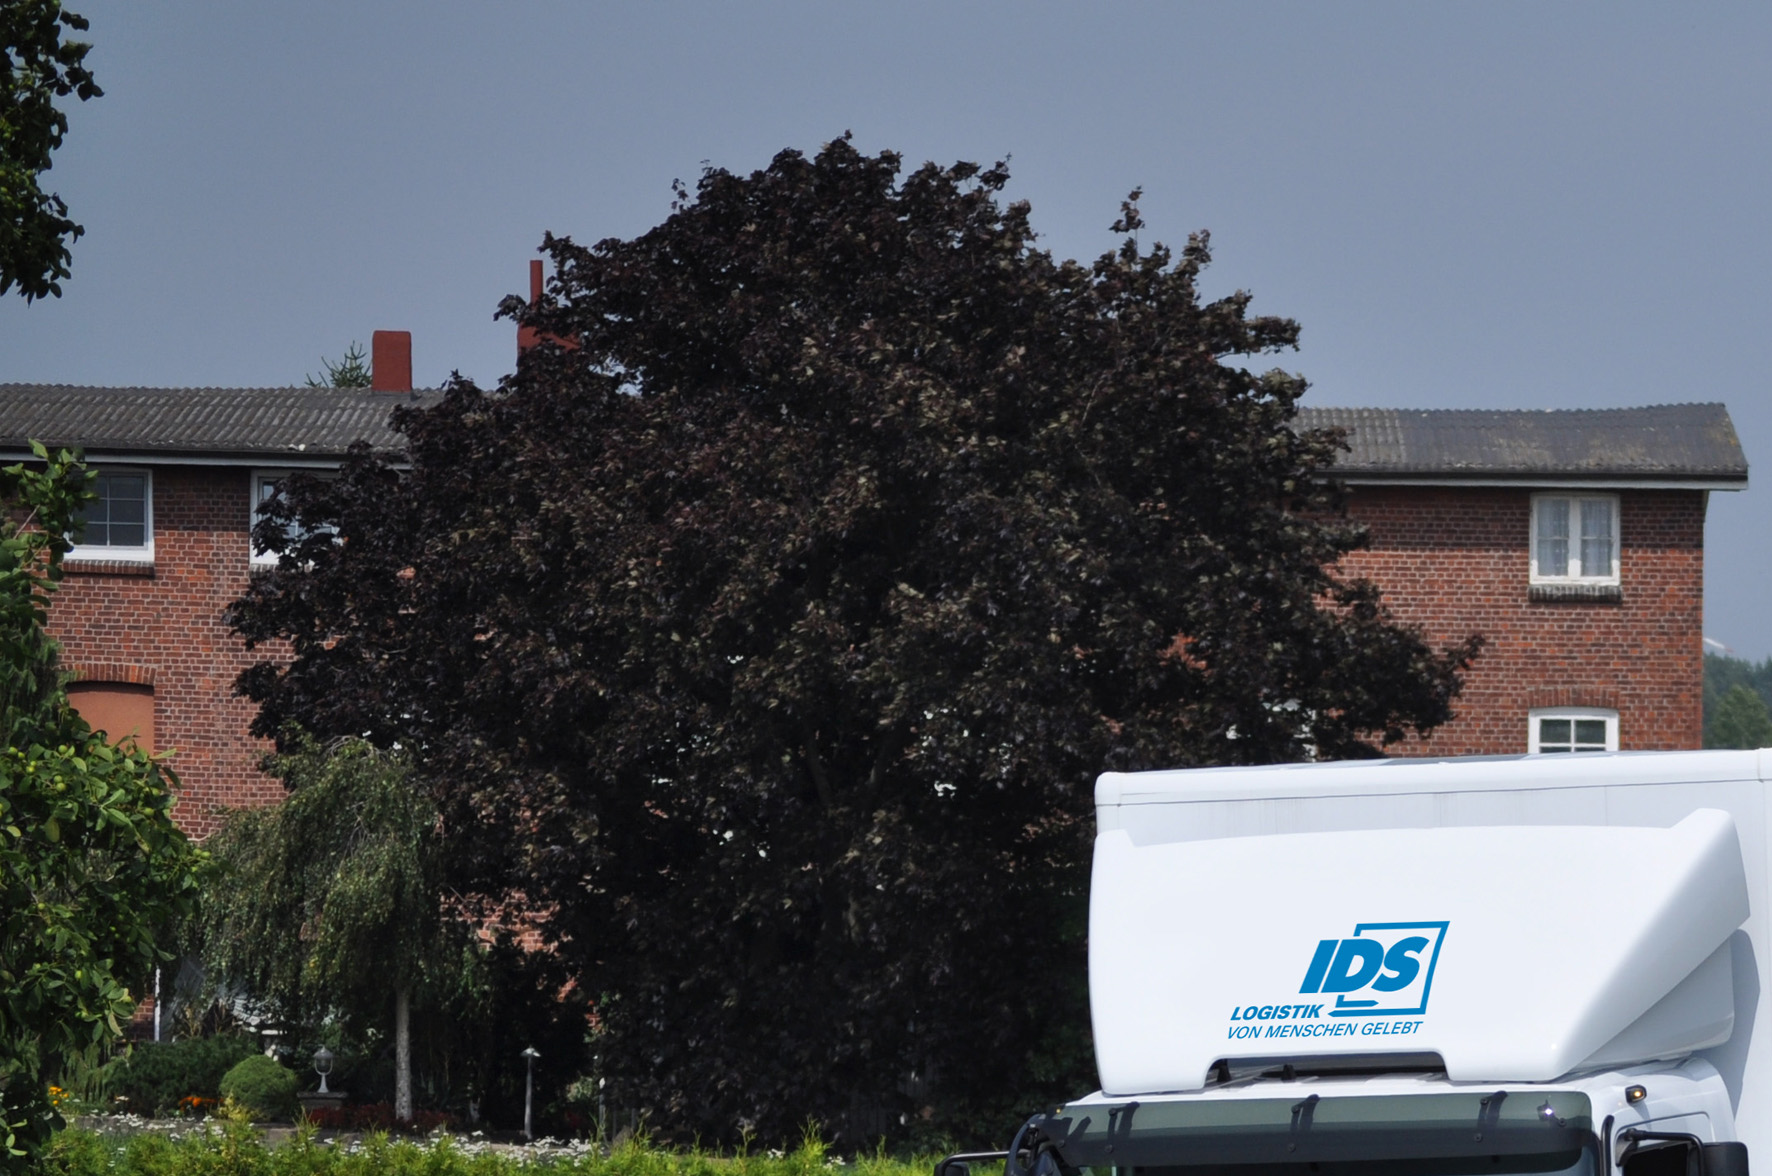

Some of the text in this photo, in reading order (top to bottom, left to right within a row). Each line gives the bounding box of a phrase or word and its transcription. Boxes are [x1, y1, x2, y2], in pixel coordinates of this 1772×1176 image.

[1298, 936, 1430, 994] IDS
[1230, 1004, 1325, 1021] LOGISTIK
[1227, 1020, 1424, 1039] VON MENSCHEN GELEBT
